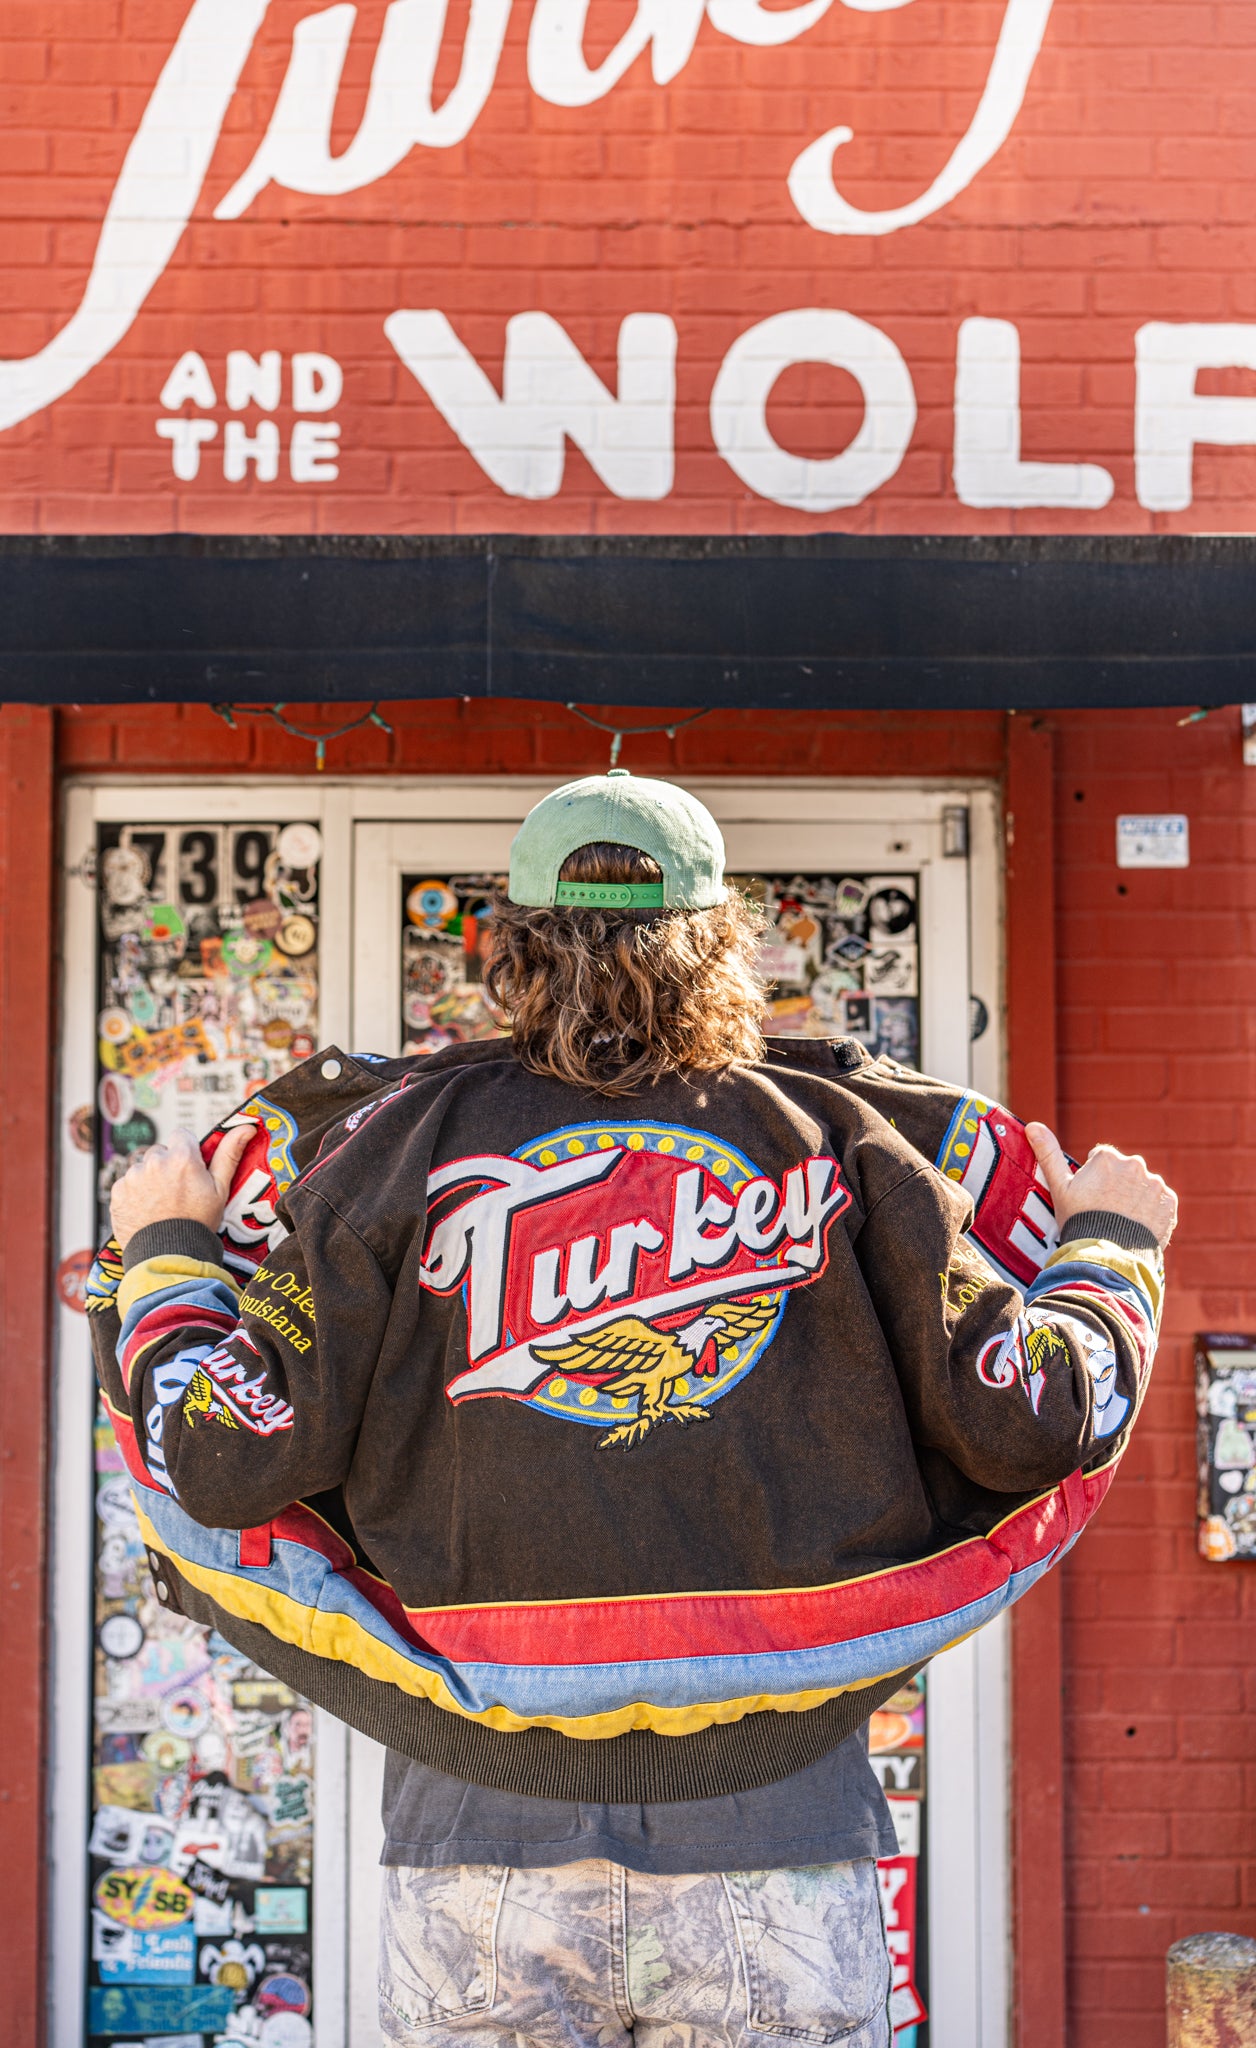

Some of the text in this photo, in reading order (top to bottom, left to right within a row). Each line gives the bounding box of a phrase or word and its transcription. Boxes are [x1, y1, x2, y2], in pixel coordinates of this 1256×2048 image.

[157, 350, 344, 414] AND
[155, 418, 342, 484] THE
[420, 1146, 852, 1368] Turkey
[239, 1293, 313, 1354] ouisiana
[200, 1347, 295, 1437] urkey
